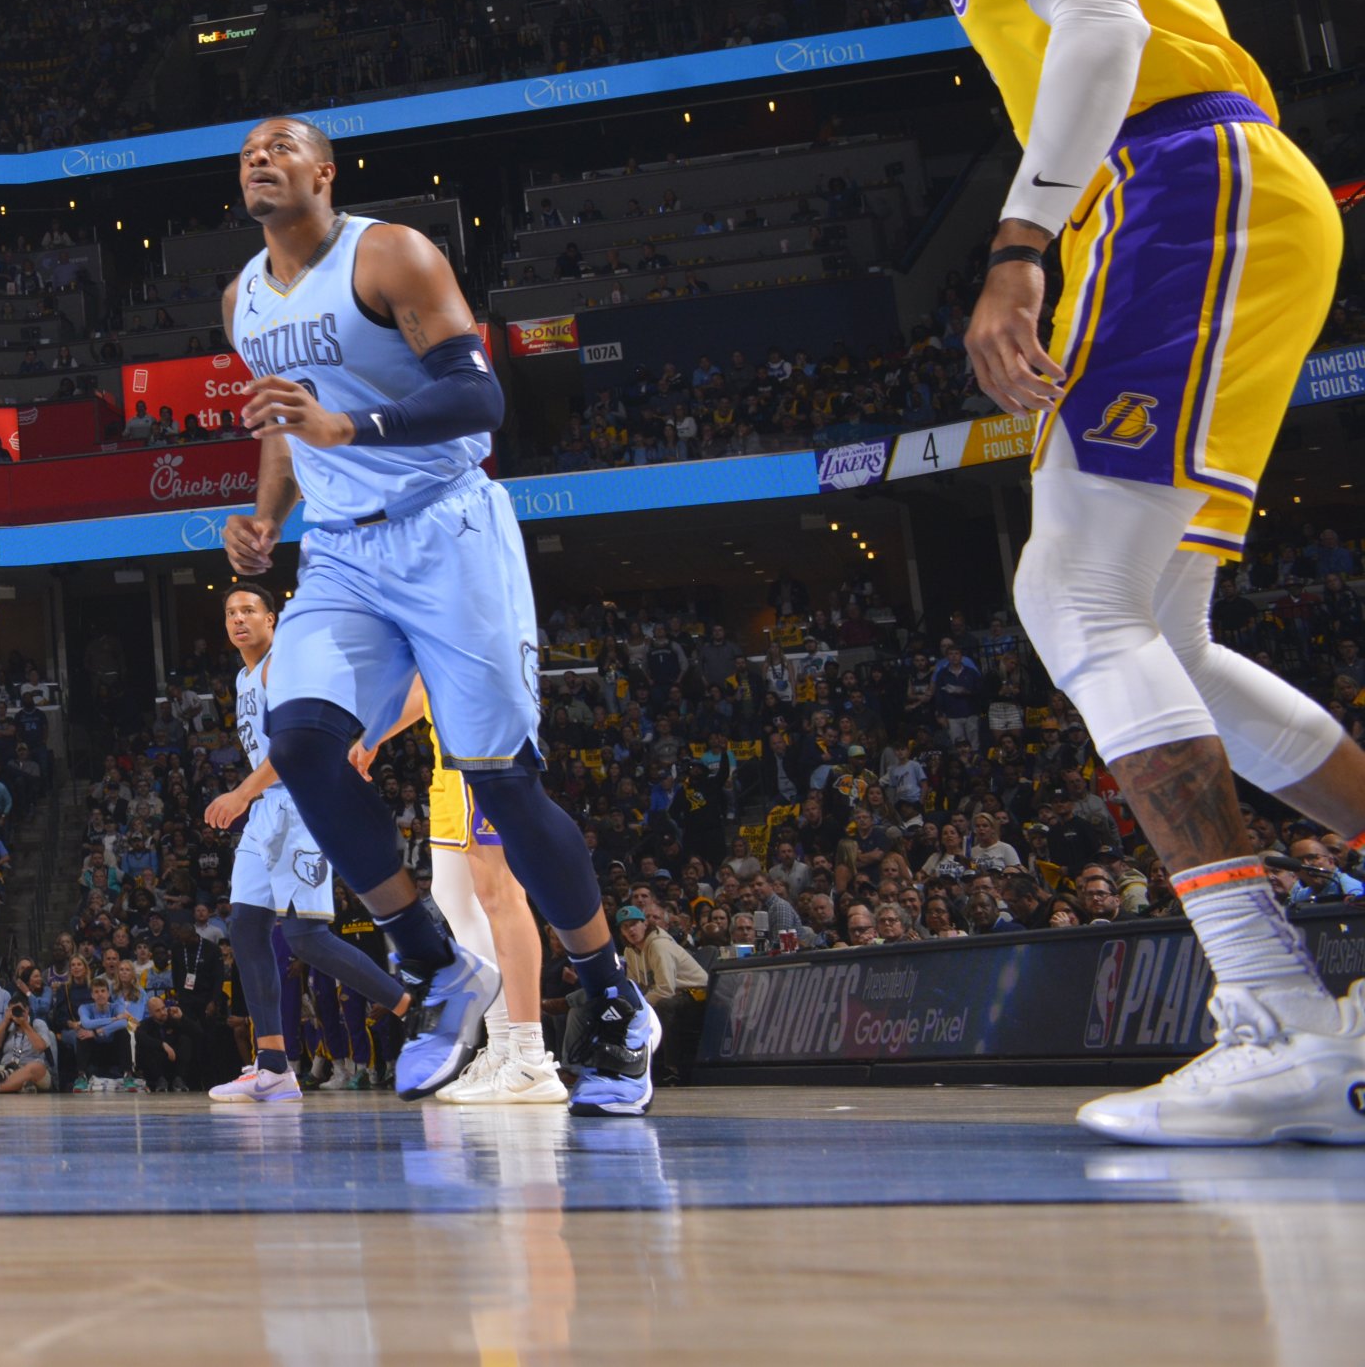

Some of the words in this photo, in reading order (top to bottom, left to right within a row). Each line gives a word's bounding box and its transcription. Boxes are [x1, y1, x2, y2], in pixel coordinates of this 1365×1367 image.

[774, 36, 866, 73] Orion
[523, 75, 608, 109] Orion
[62, 146, 137, 176] Orion
[242, 313, 343, 380] GRIZZLIES
[523, 325, 571, 339] SONIC
[586, 345, 618, 361] 107A
[822, 450, 883, 481] LAKERS
[923, 433, 939, 468] 4
[984, 441, 1030, 460] FOULS:
[741, 962, 860, 1056] PLAYOFFS
[854, 1010, 919, 1052] Google
[922, 1008, 968, 1043] Pixel
